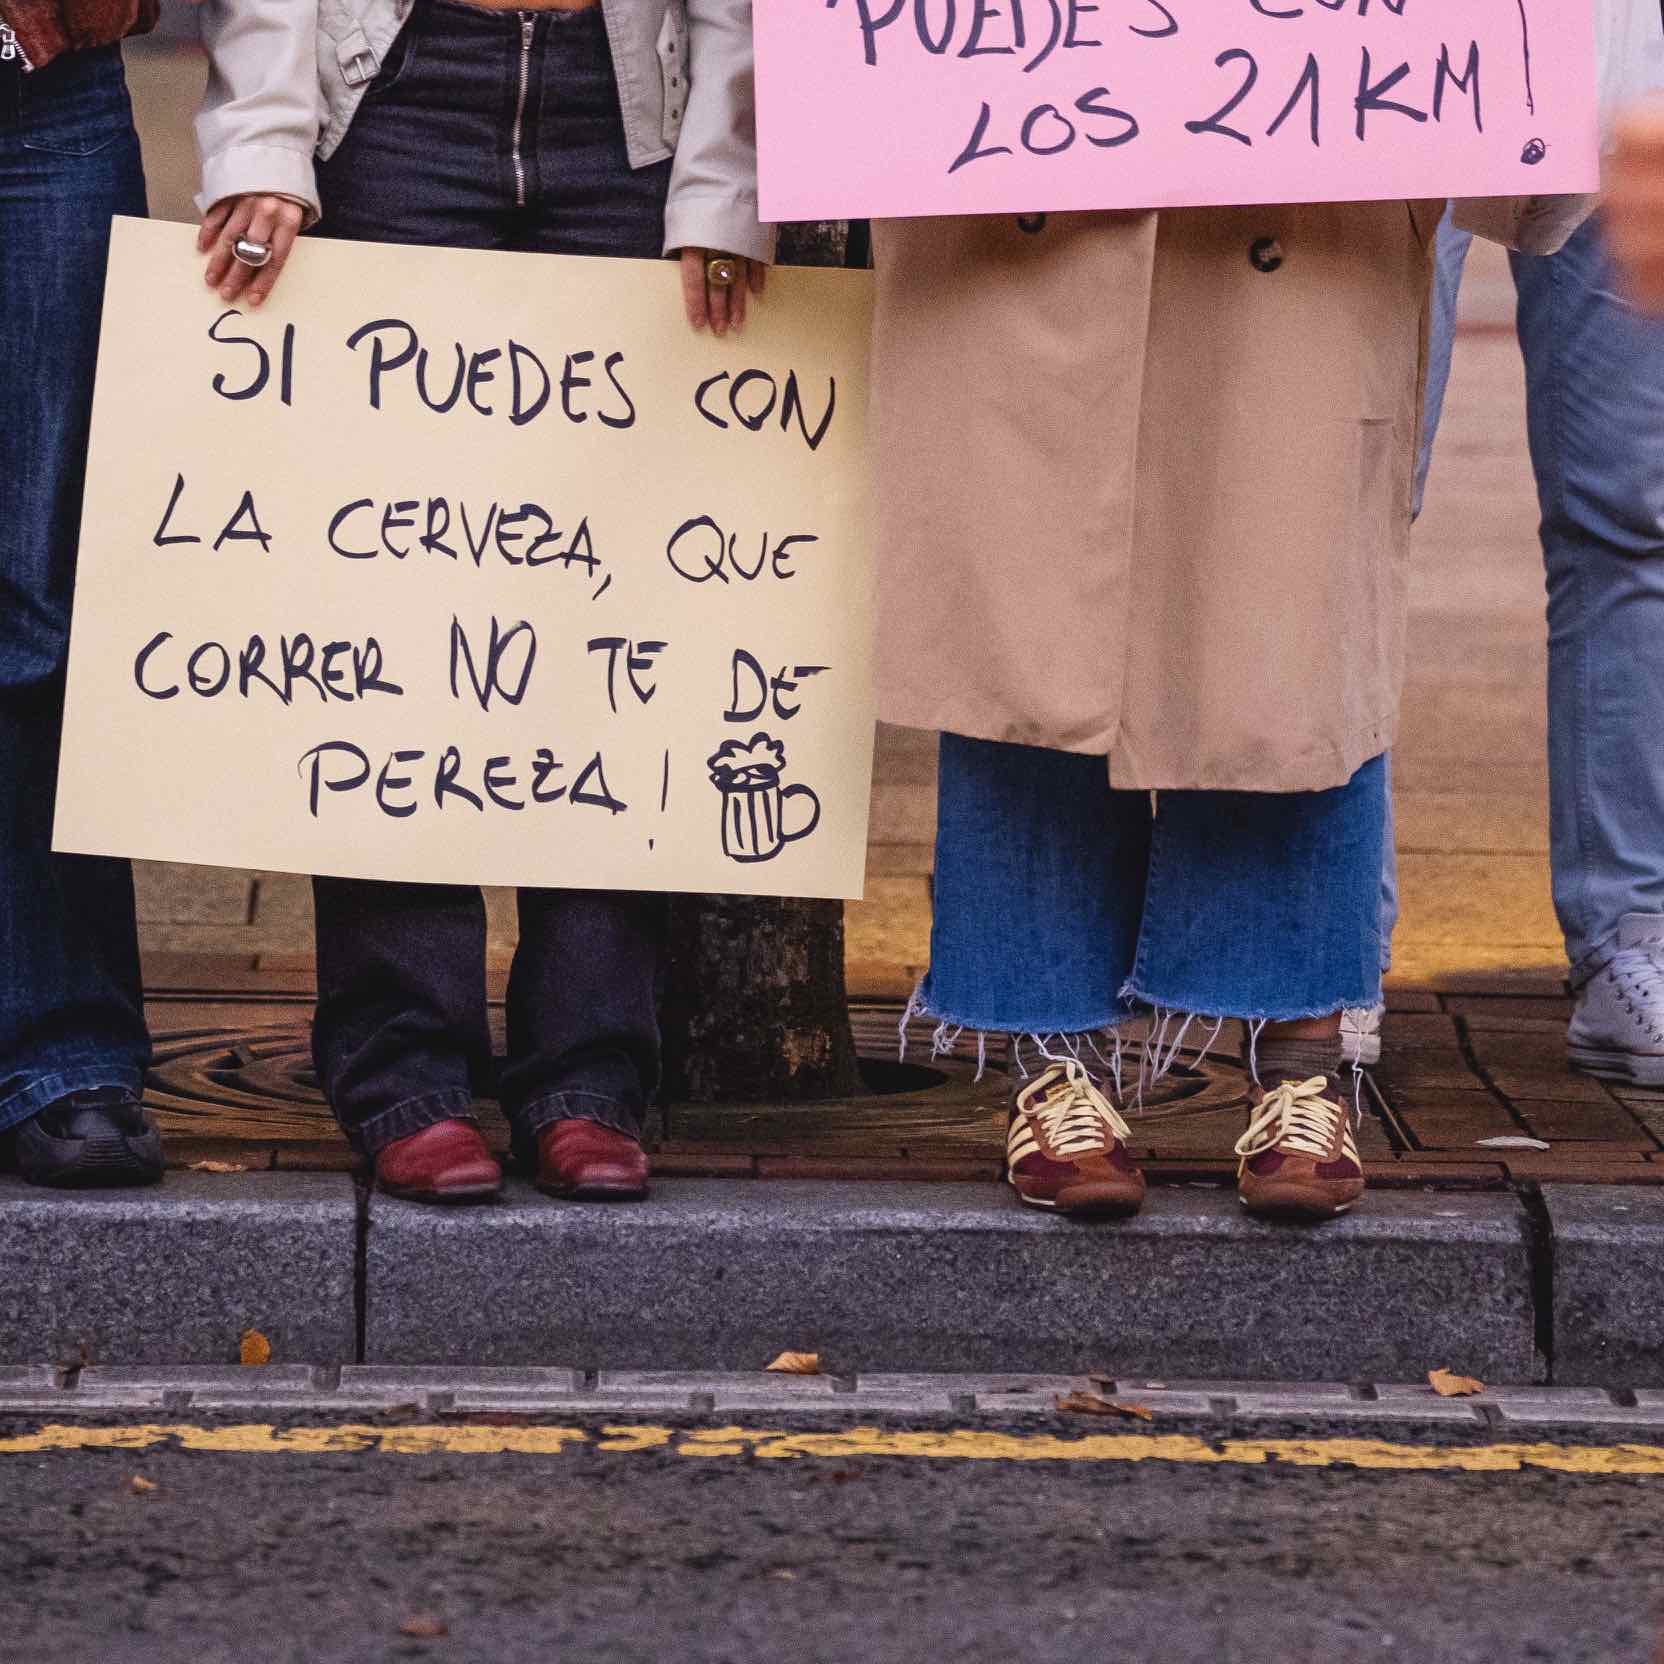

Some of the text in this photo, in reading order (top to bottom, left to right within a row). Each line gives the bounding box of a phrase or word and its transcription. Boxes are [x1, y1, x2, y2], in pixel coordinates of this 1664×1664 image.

[947, 86, 1139, 174] LOS
[207, 308, 837, 452] SI PUEDES CON
[152, 472, 820, 602] LA CERVEZA, QUE
[133, 614, 832, 724] CORRER NO TE DE
